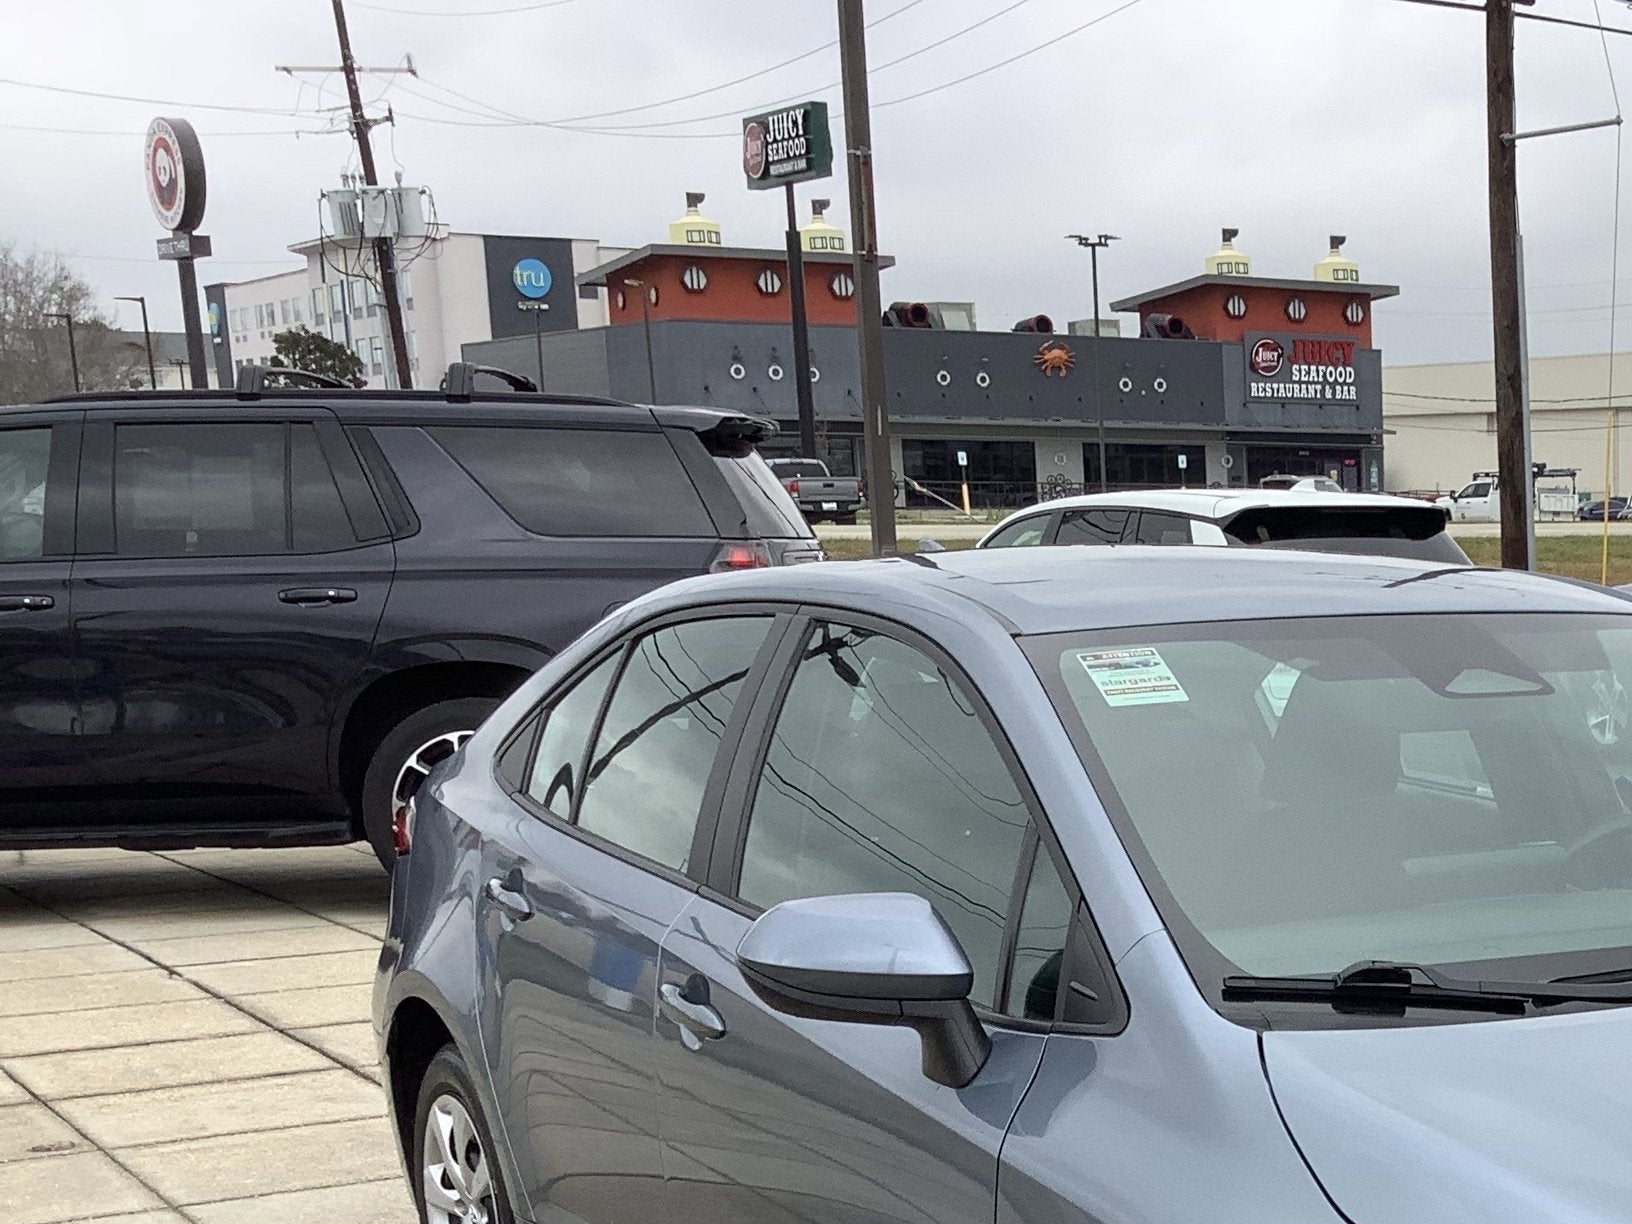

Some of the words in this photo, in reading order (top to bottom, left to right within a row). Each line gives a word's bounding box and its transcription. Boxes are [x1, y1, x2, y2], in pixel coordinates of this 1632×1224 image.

[766, 109, 804, 143] JUICY
[767, 136, 806, 162] SEAFOOD
[513, 264, 545, 287] tru
[1287, 340, 1354, 365] JUICY
[1292, 364, 1355, 384] SEAFOOD
[1250, 382, 1322, 398] RESTAURANT
[1325, 385, 1333, 399] &
[1335, 385, 1357, 400] BAR
[1102, 649, 1152, 659] ATTENTION
